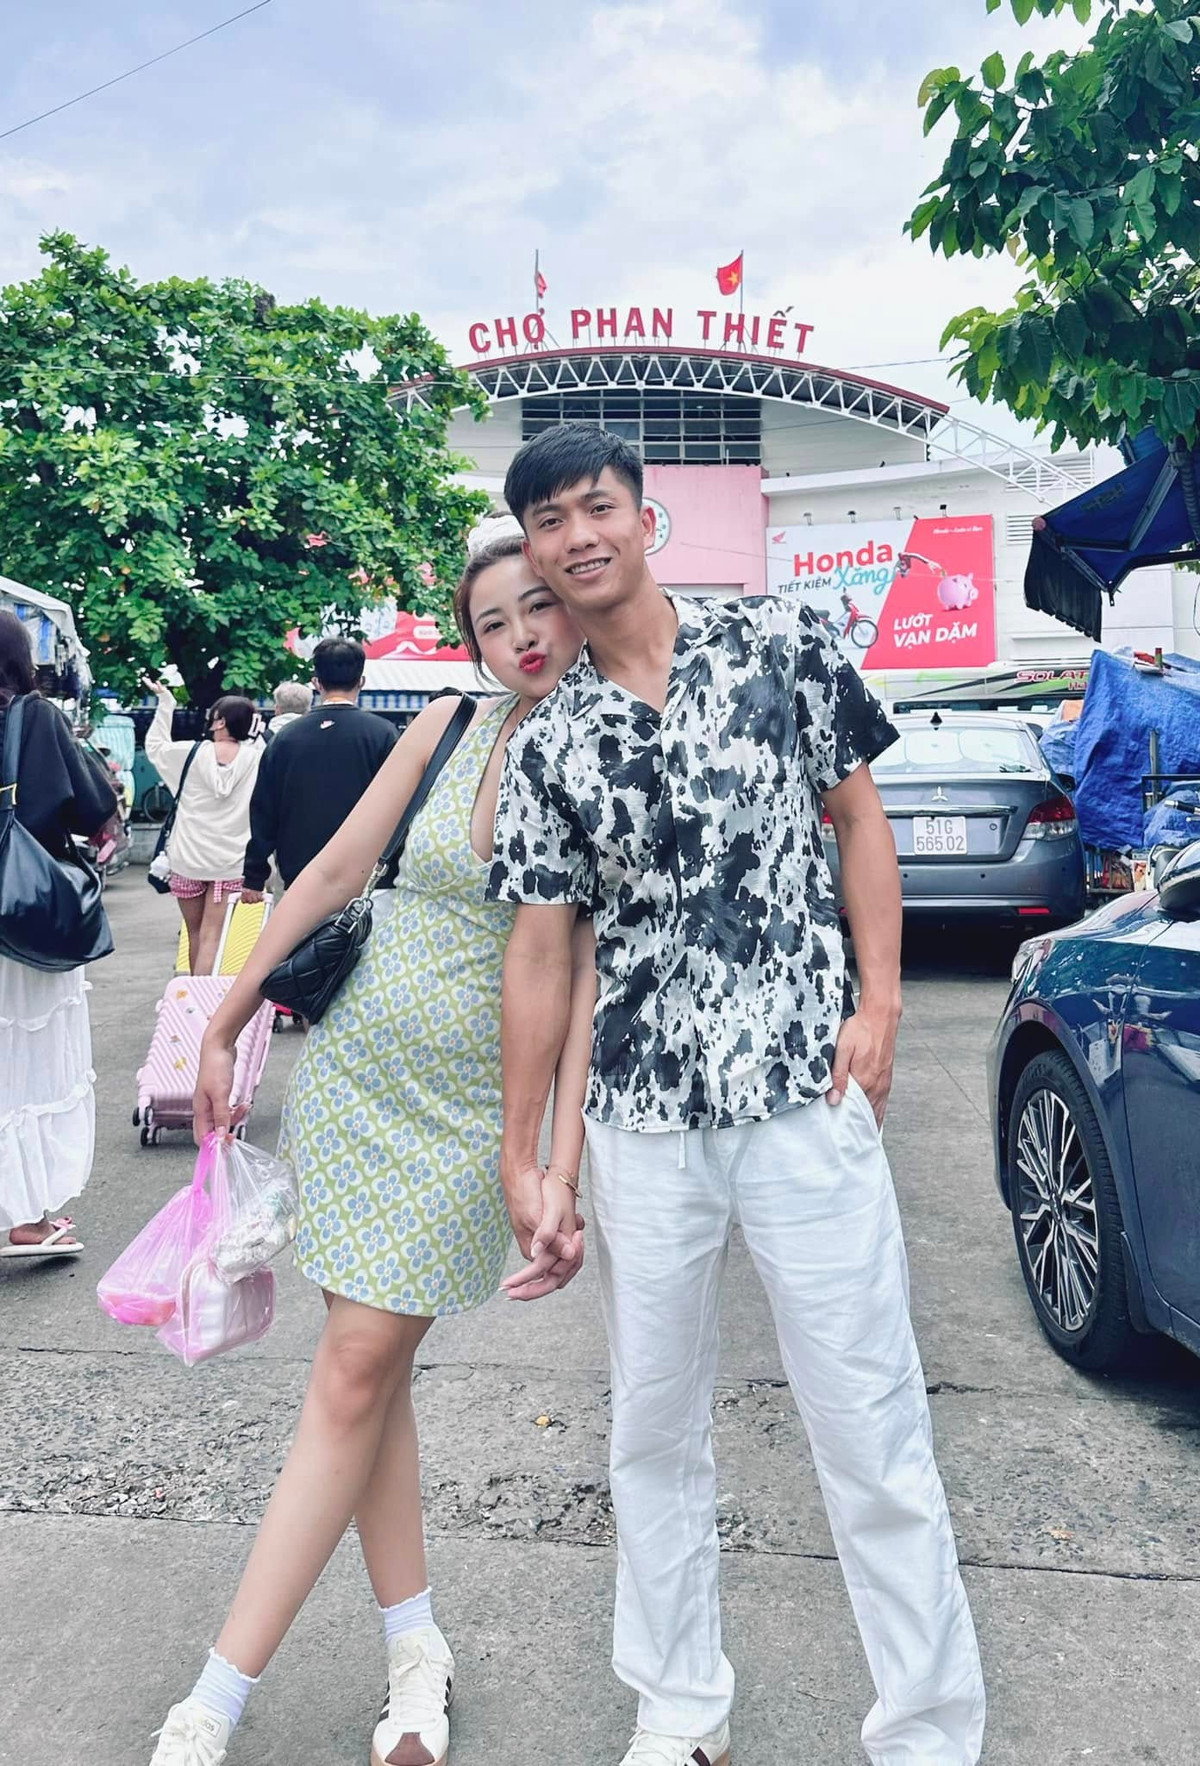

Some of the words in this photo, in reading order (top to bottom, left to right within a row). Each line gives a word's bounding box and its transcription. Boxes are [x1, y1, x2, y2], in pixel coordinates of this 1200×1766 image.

[469, 308, 545, 353] CHỢ
[571, 307, 673, 340] PHAN
[697, 305, 815, 353] THIẾT
[794, 540, 893, 577] Honda
[778, 579, 802, 594] TIẾT
[804, 576, 831, 591] KIỆM
[893, 629, 931, 650] VẠN
[935, 621, 978, 644] DẶM
[926, 819, 953, 835] 51G
[916, 835, 965, 851] 565.02
